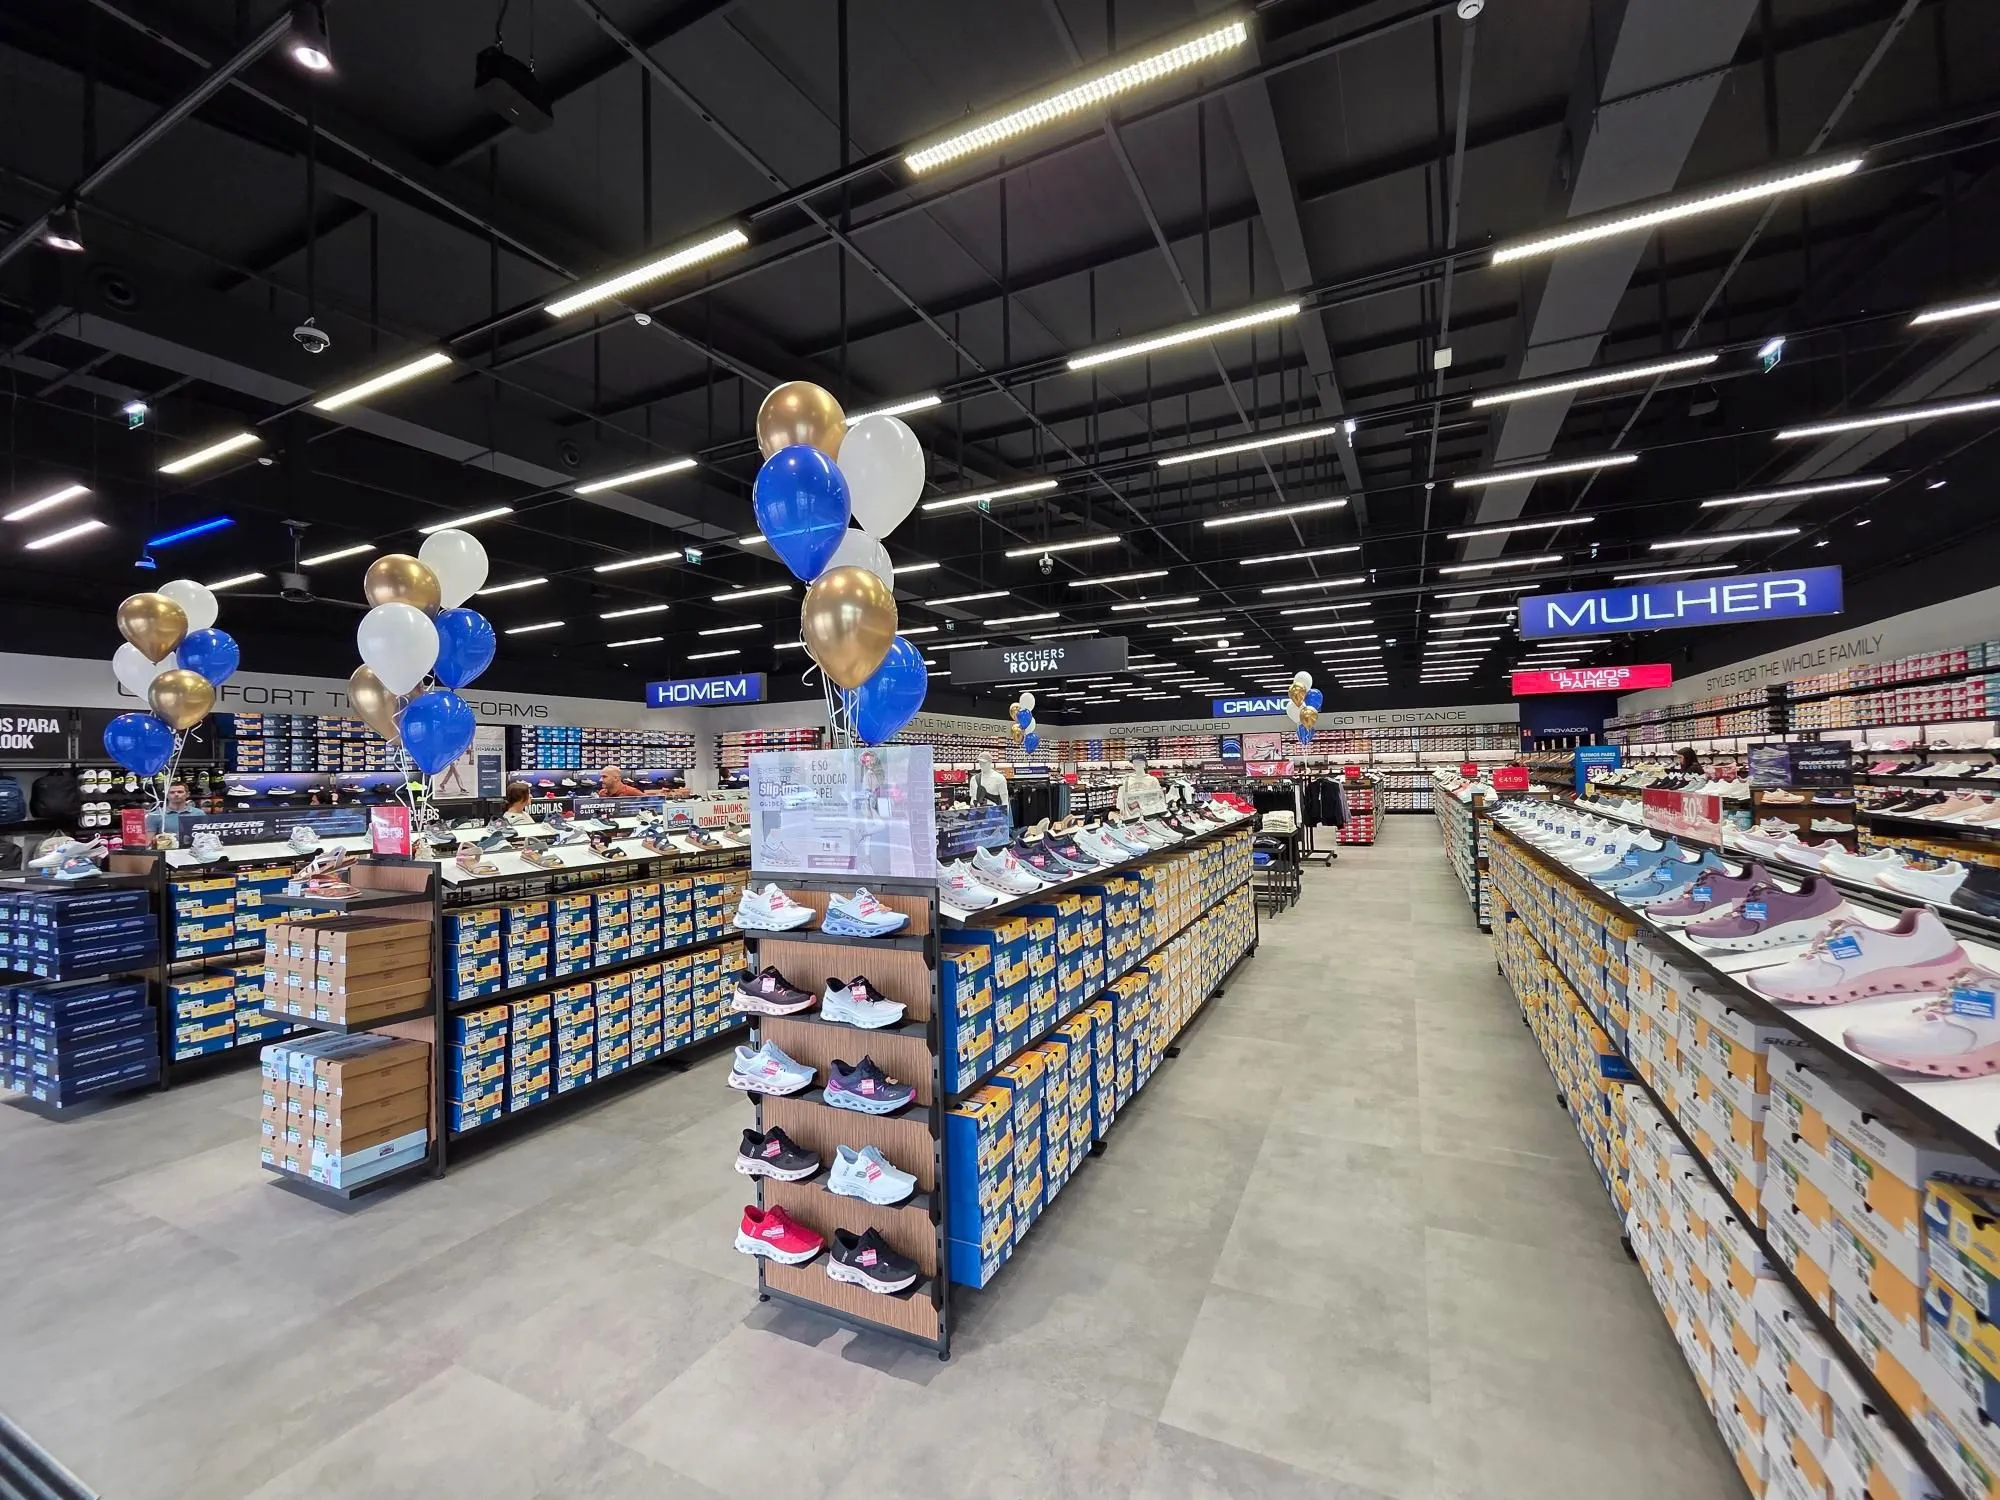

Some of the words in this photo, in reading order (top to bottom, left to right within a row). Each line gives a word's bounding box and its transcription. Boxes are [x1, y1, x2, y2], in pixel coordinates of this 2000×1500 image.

[1547, 578, 1807, 629] MULHER
[1003, 648, 1065, 663] SKECHERS
[1706, 672, 1736, 692] STYLES
[1738, 666, 1758, 683] FOR
[1758, 661, 1780, 678] THE
[1781, 649, 1826, 674] WHOLE
[1829, 633, 1884, 663] FAMILY
[1009, 659, 1059, 673] ROUPA
[1550, 668, 1630, 682] ÚLTIMOS
[1559, 677, 1621, 690] PARES
[658, 679, 747, 703] HOMEM
[908, 717, 933, 728] STYLE
[936, 720, 955, 729] THAT
[957, 721, 971, 731] FITS
[973, 723, 1007, 733] EVERYONE
[1333, 716, 1354, 725] GO
[1360, 714, 1387, 723] THE
[1391, 711, 1467, 723] DISTANCE
[0, 718, 14, 733] S
[17, 718, 61, 734] PARA
[1109, 725, 1166, 735] COMFORT
[1169, 722, 1231, 732] INCLUDED
[1543, 726, 1589, 734] PROVADOR
[0, 734, 35, 750] OOK
[812, 774, 848, 785] COLOCAR
[526, 802, 563, 815] MOCHILAS
[713, 803, 743, 815] MILLIONS
[191, 820, 265, 831] SKECHERS
[698, 815, 729, 827] DONATED
[191, 828, 264, 838] GDE-STEP
